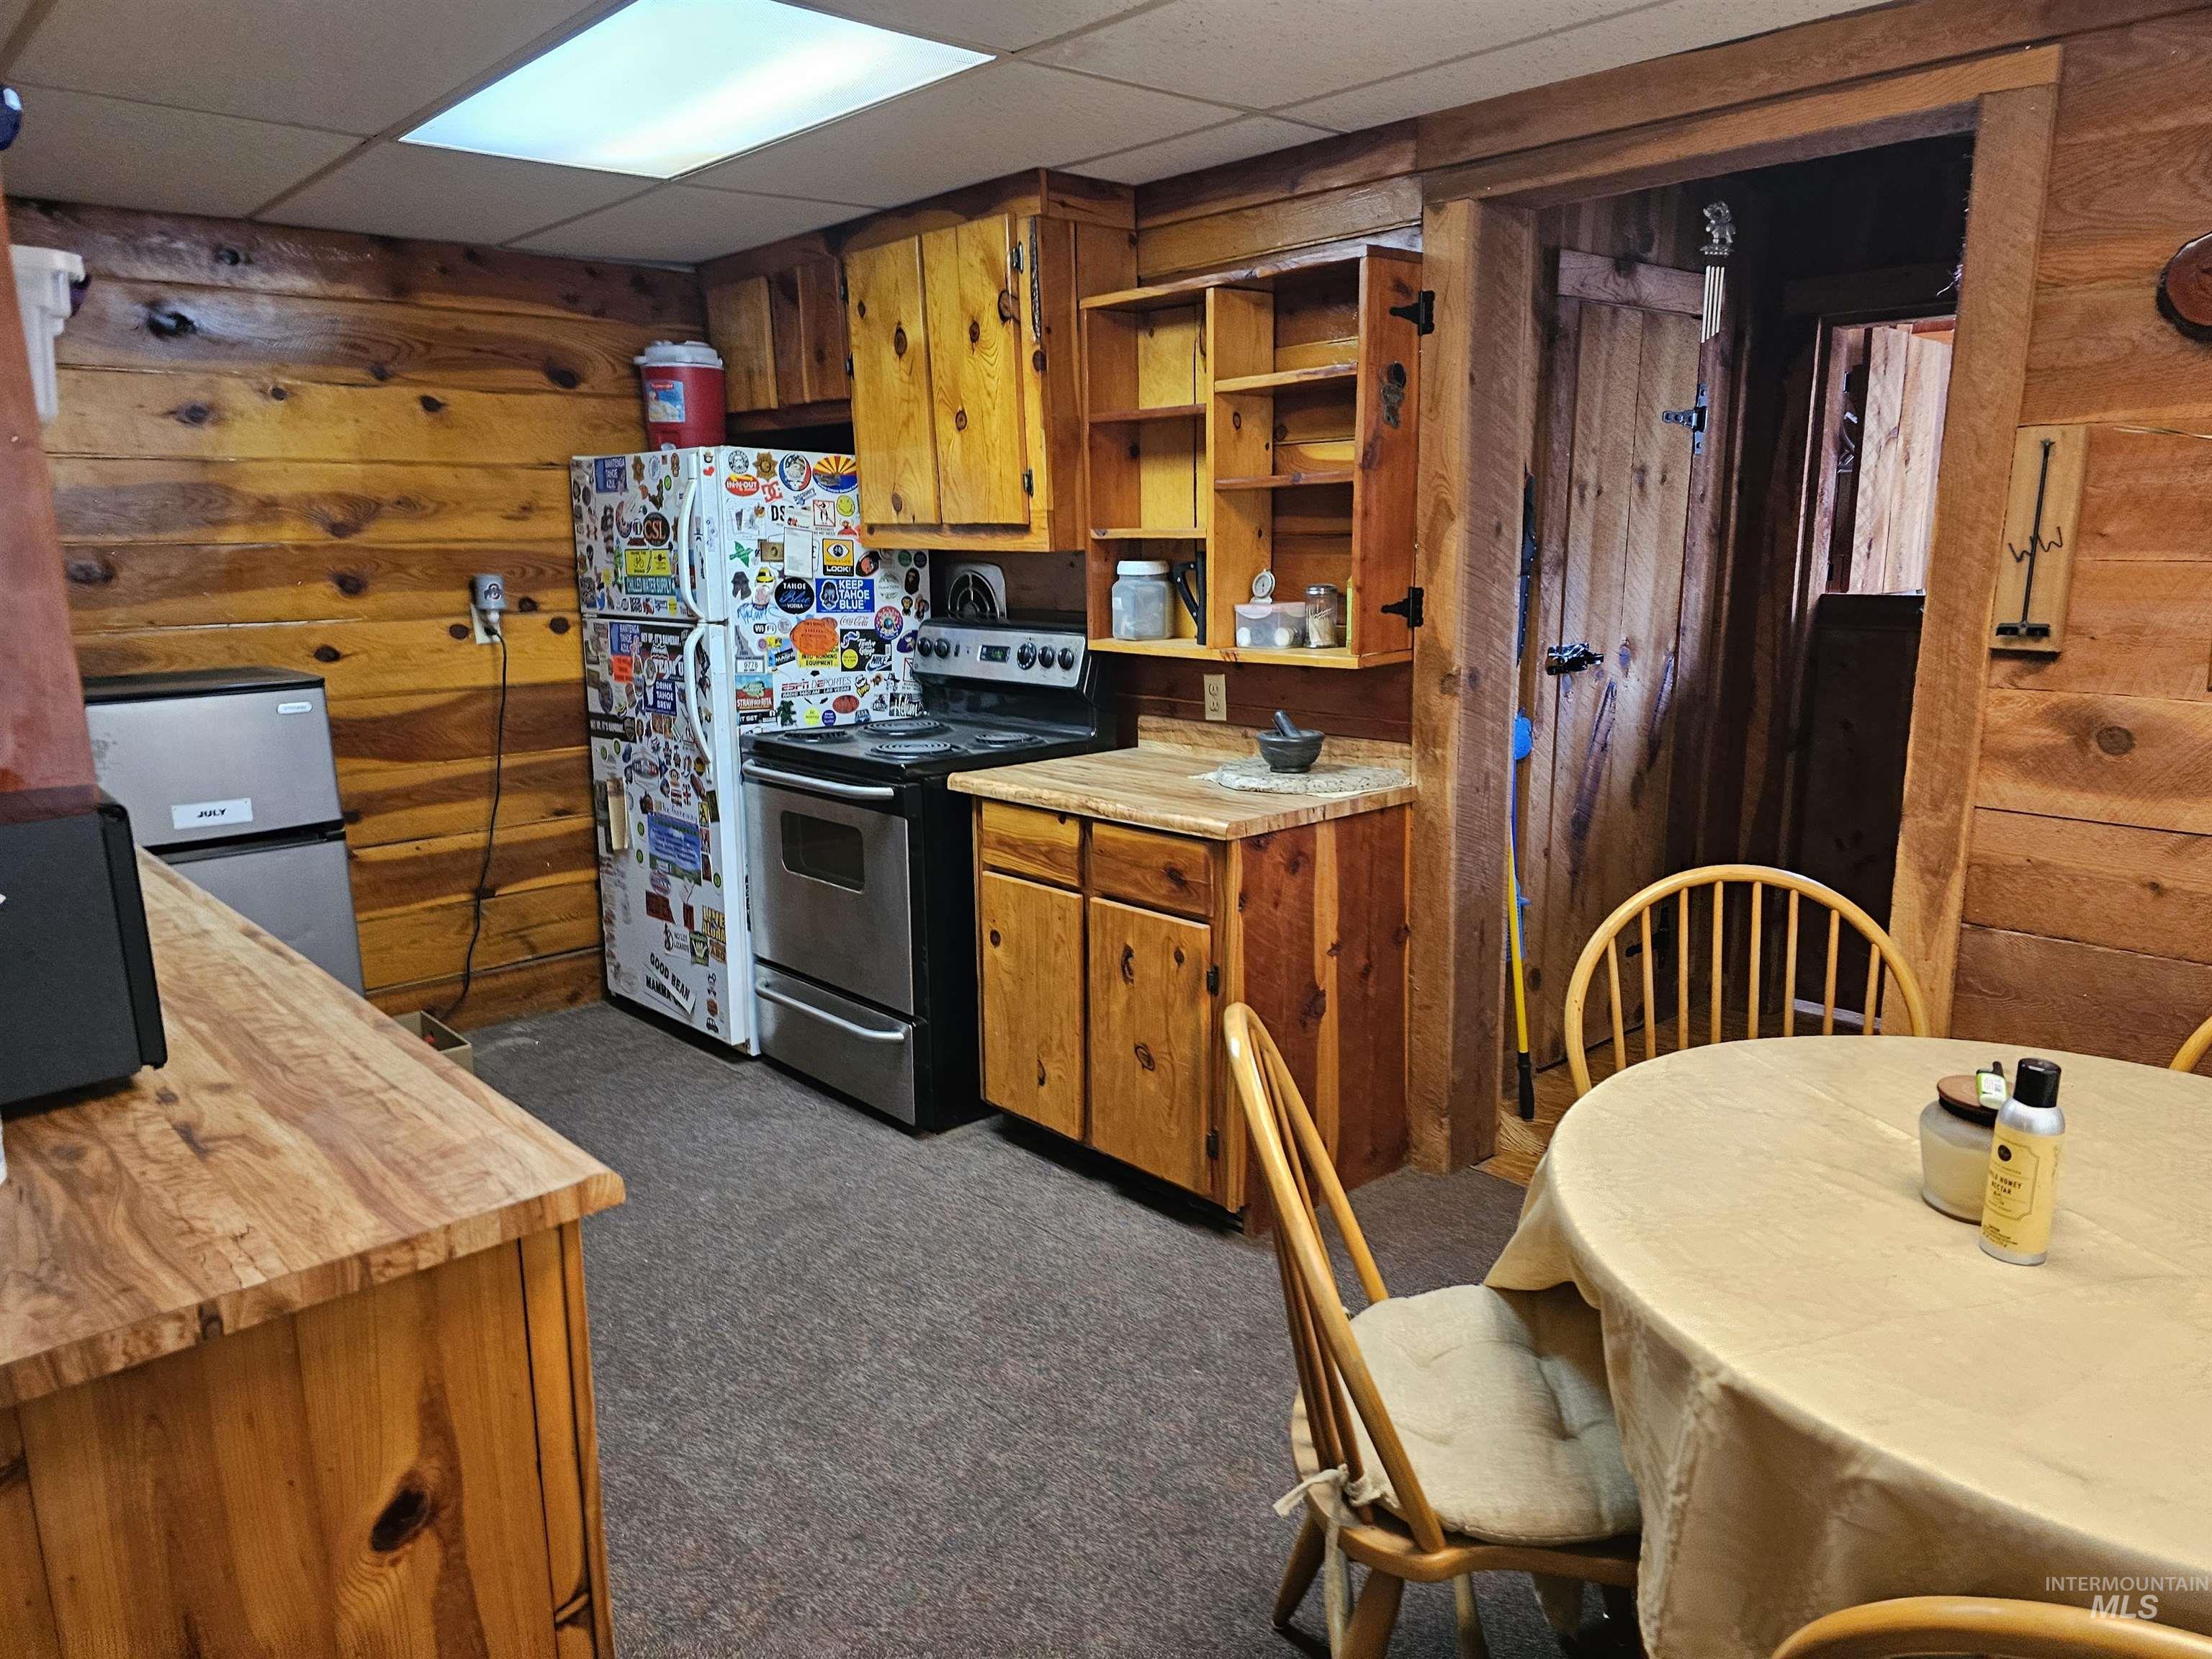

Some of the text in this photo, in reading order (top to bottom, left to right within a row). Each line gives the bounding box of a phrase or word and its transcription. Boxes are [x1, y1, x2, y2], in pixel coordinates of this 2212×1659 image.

[644, 520, 665, 540] CSL
[839, 579, 863, 589] KEEP
[839, 590, 871, 599] TAHOE
[839, 600, 864, 610] BLUE
[656, 680, 673, 691] DRINK
[811, 677, 852, 688] DEPORTES
[656, 691, 674, 701] TAHOE
[657, 700, 672, 710] BREW
[197, 808, 227, 818] JULY
[702, 904, 725, 928] LIVE
[701, 920, 726, 945] ALOHA
[650, 952, 690, 1002] GOOD BEAN
[1991, 1180, 2012, 1195] NECTAR
[2000, 1176, 2022, 1190] HONEY
